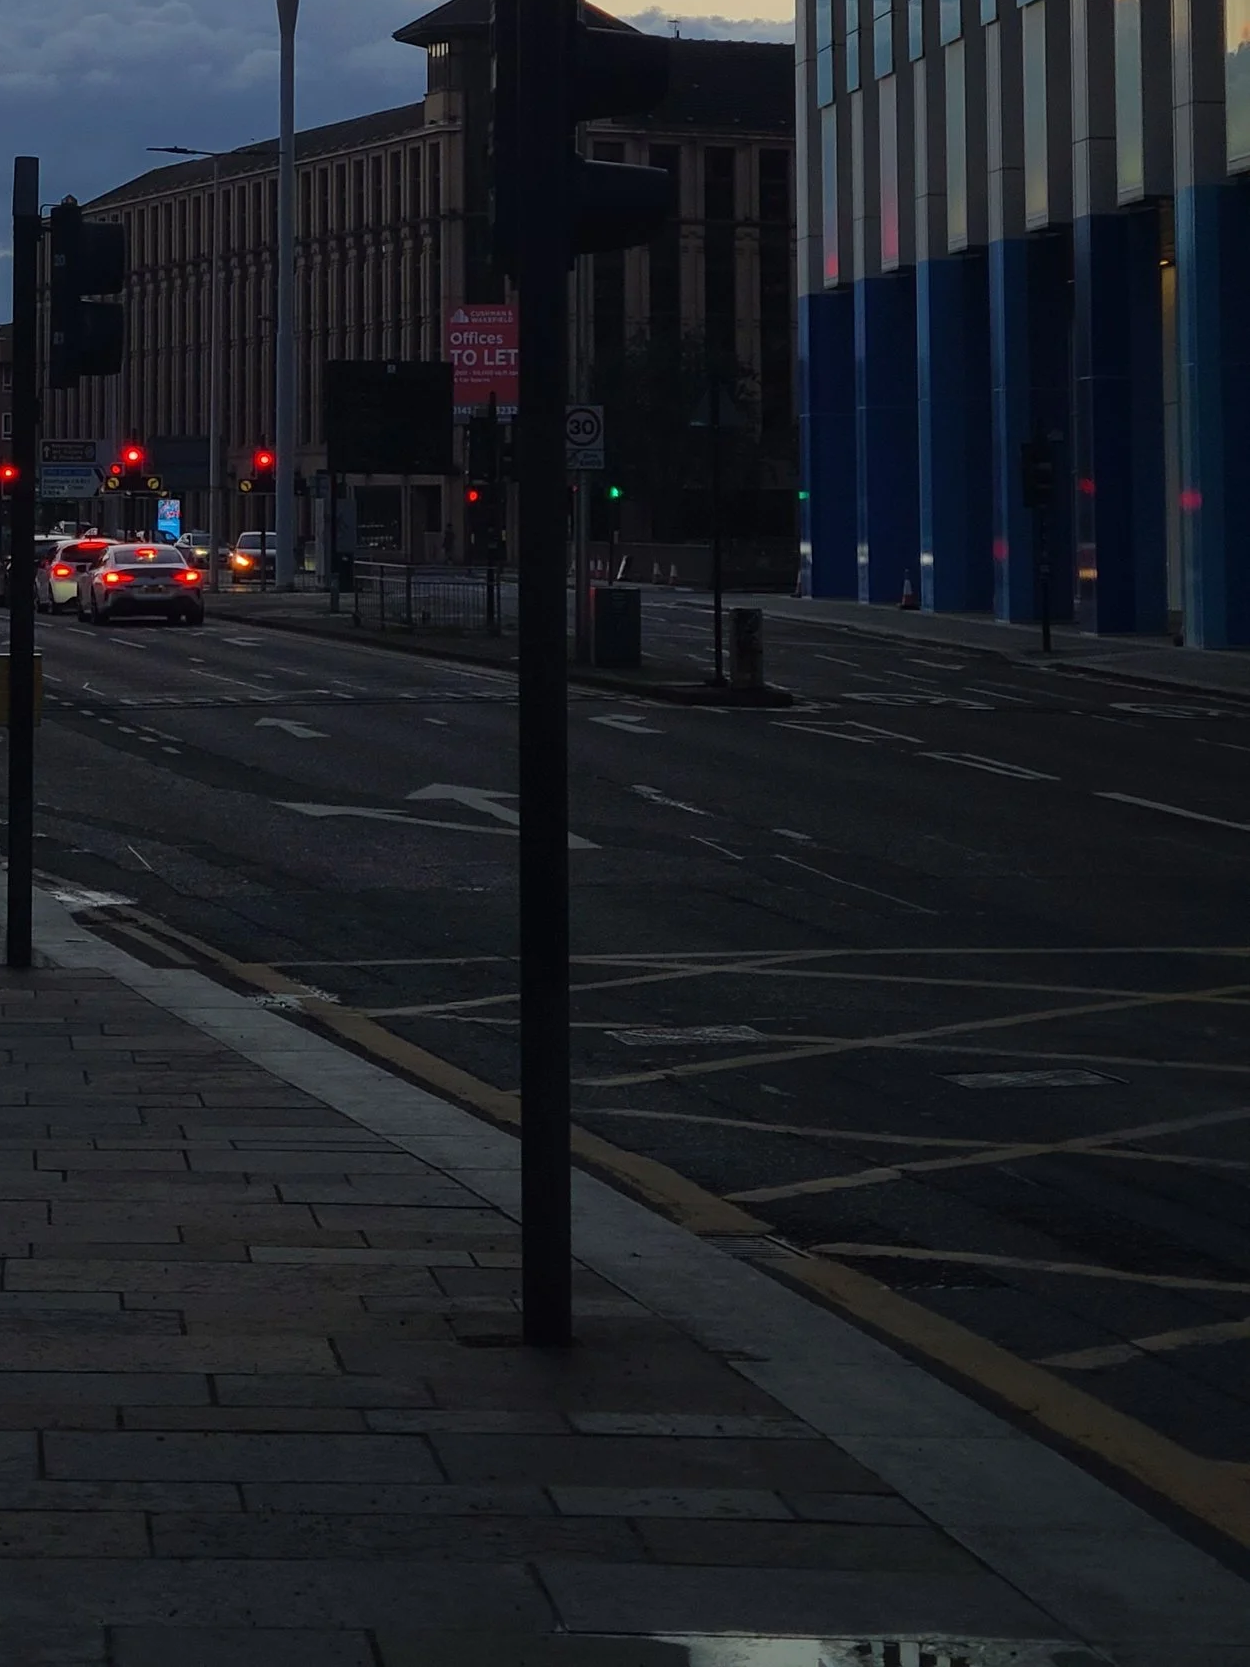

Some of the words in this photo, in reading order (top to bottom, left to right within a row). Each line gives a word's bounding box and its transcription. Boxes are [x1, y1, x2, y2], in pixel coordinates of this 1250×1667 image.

[450, 331, 503, 345] Offices
[449, 349, 477, 366] TO
[484, 349, 519, 366] LET
[569, 419, 595, 435] 30
